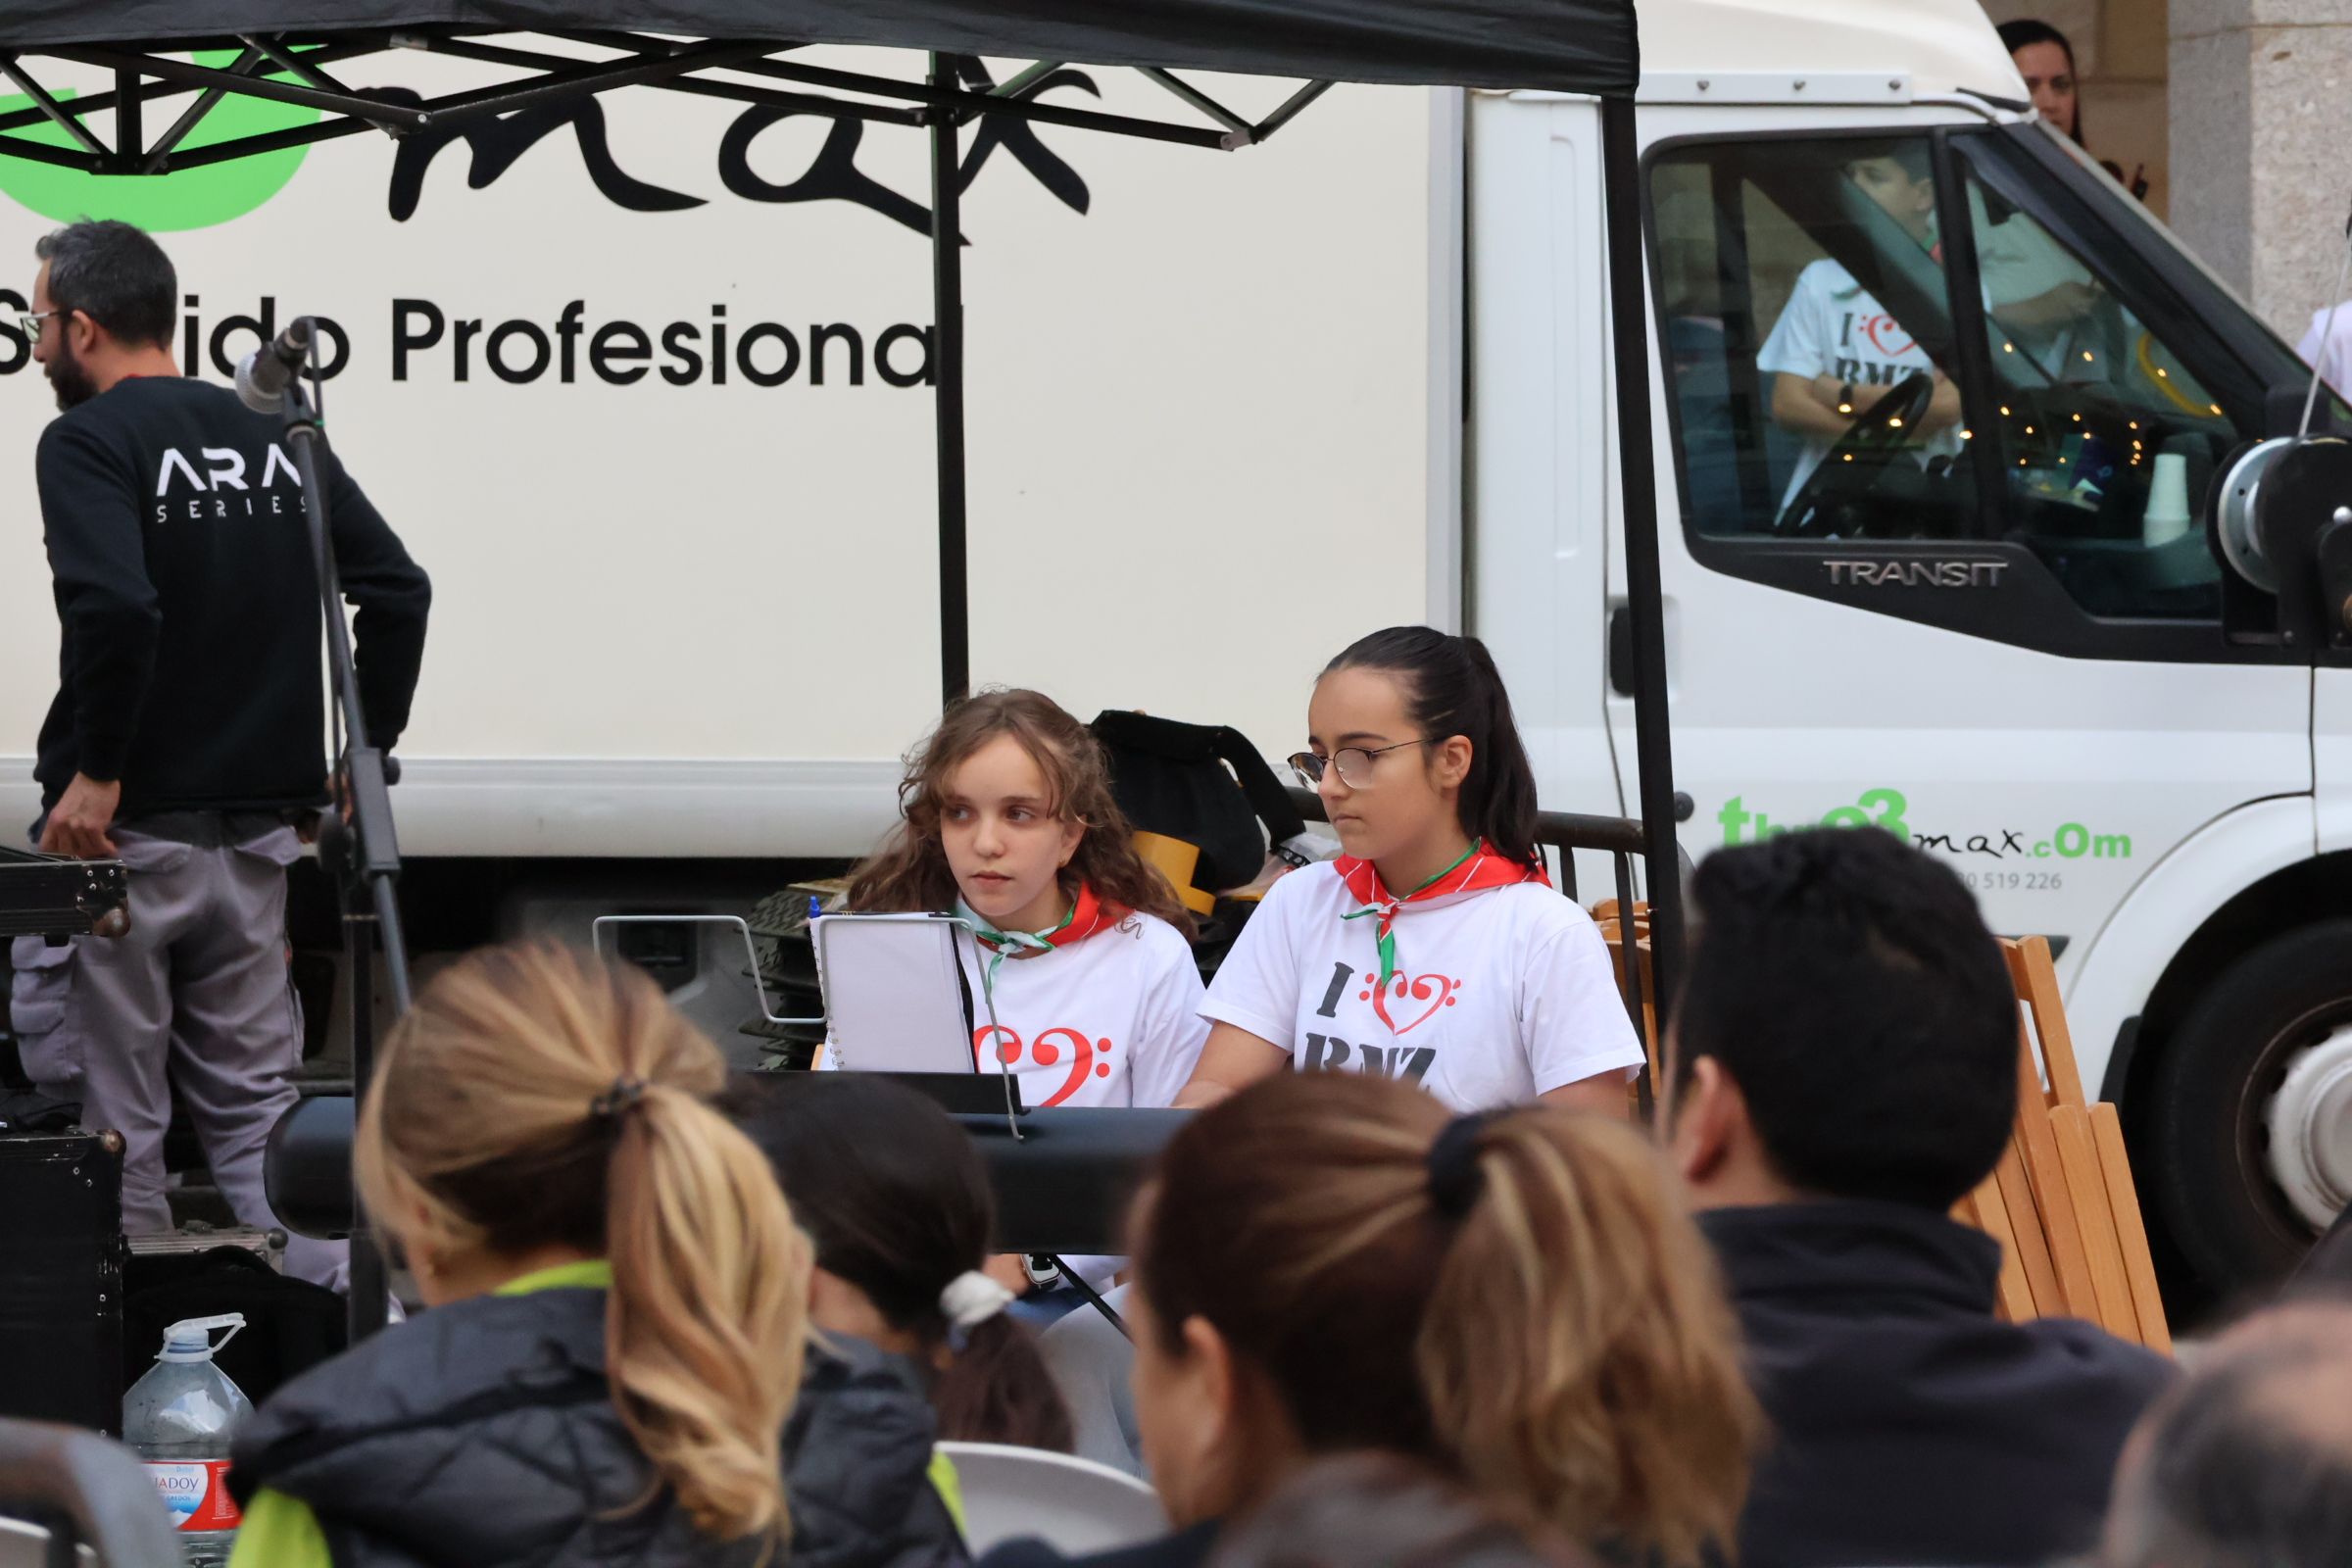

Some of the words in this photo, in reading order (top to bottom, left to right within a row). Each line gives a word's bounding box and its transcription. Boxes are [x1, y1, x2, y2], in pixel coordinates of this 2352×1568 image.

[0, 288, 350, 381] Sido
[392, 299, 963, 387] Profesiona
[157, 443, 302, 497] ARA
[1823, 561, 2008, 587] TRANSIT
[1984, 871, 2020, 890] 519
[2026, 871, 2063, 890] 226
[1316, 961, 1354, 1018] I
